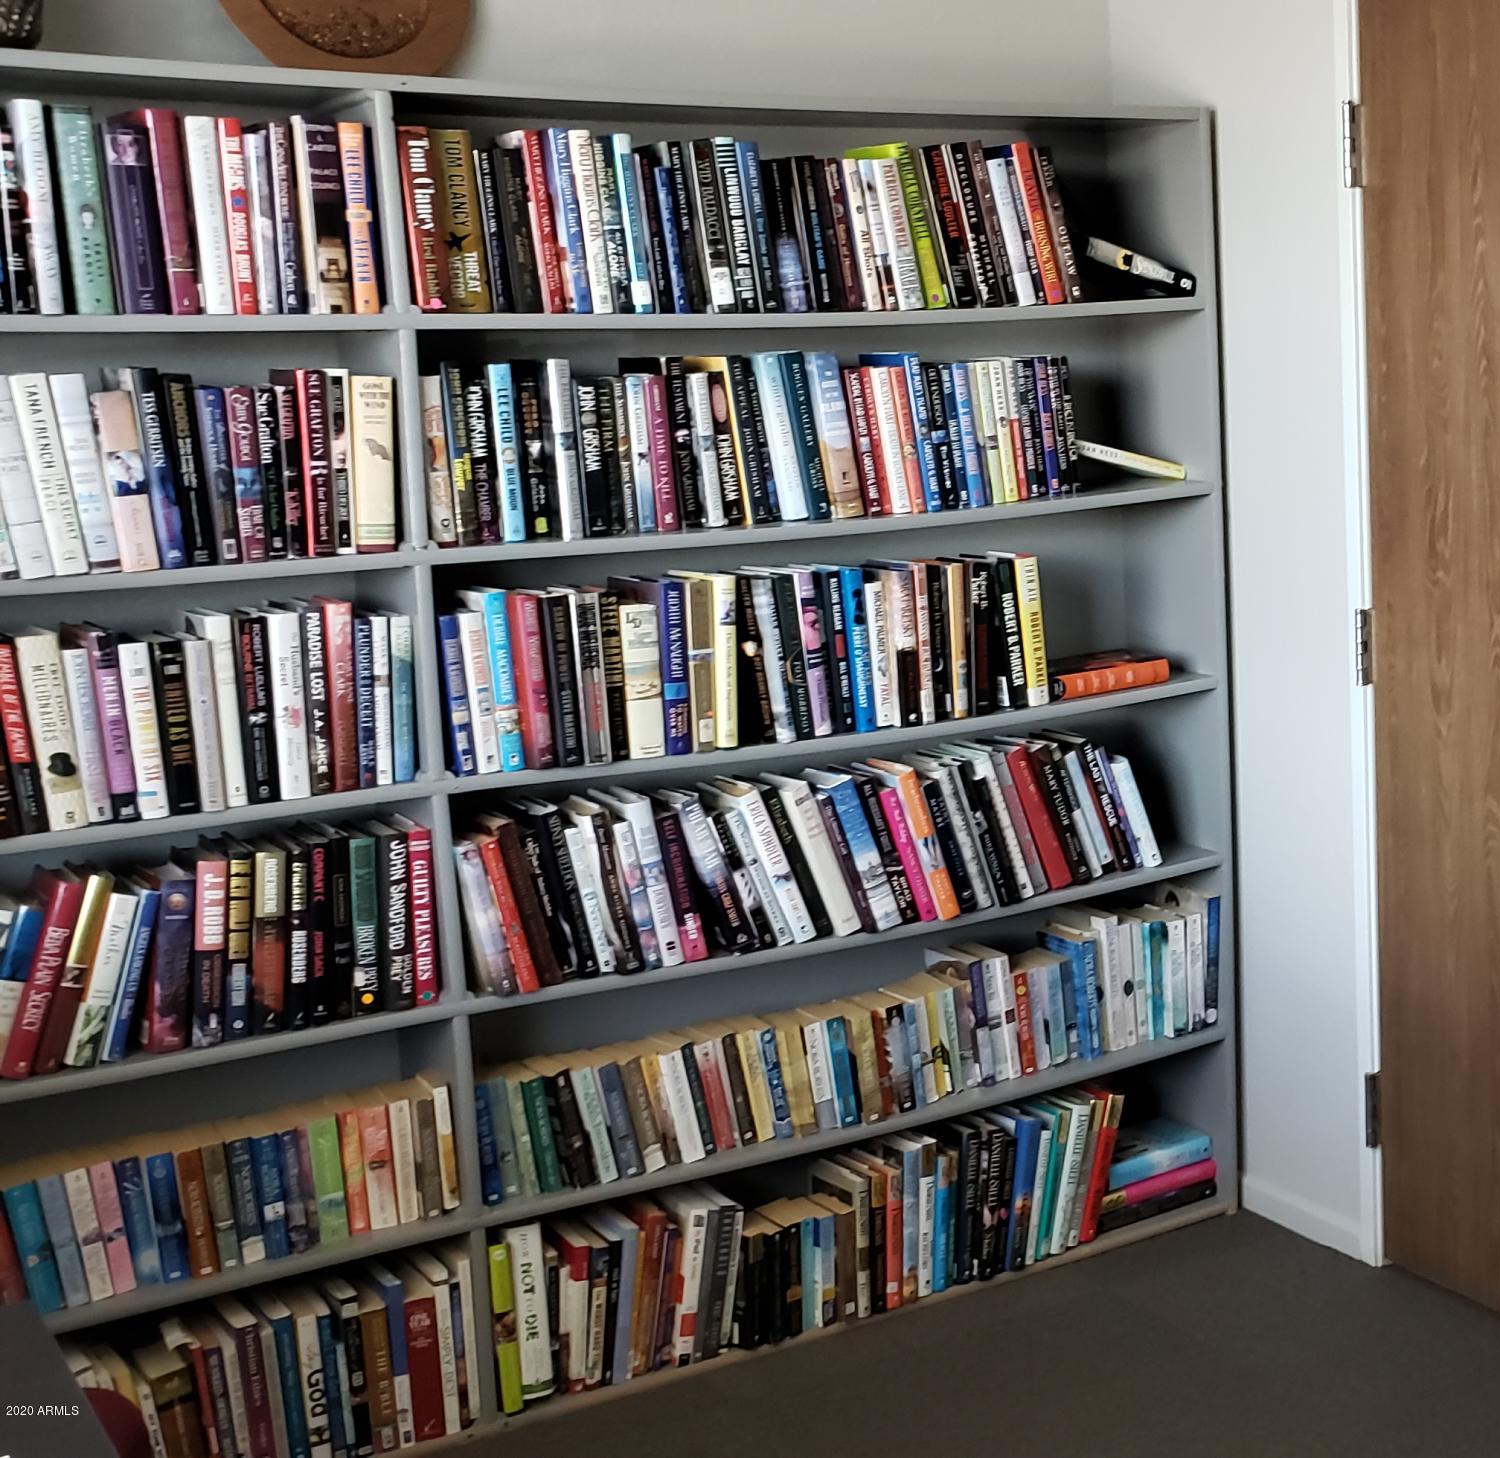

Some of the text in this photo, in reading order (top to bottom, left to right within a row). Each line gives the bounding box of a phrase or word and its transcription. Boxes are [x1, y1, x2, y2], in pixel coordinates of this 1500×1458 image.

[345, 150, 360, 167] LEE
[408, 138, 437, 231] Tom Clancy
[444, 139, 472, 228] TOM CLANCY
[955, 153, 978, 224] DISCLOSURE
[539, 203, 551, 235] CLARK
[560, 163, 580, 235] Higgins Clark
[701, 186, 721, 240] BALDACCI
[723, 168, 751, 265] LINWOOD BARCLAY
[883, 163, 909, 250] PATRICIA CORNWELL
[931, 150, 960, 239] CATHERINE COULTER
[463, 251, 482, 294] THREAT
[979, 234, 996, 285] MICHAEL
[1033, 220, 1052, 262] BURNING
[1057, 226, 1078, 276] OUTLAW
[24, 384, 57, 470] TANA FRENCH
[142, 391, 167, 468] TESS GERRITSEN
[256, 391, 277, 465] Sue Grafton
[308, 373, 325, 457] SUE GRAFTON
[577, 385, 602, 472] JOHN GRISHAM
[601, 419, 615, 453] FIRM
[732, 362, 762, 498] THE APPEAL JOHN GRISHAM
[800, 404, 815, 448] GALLERY
[467, 385, 493, 522] JOHN GRISHAM CHAMBER
[497, 387, 519, 511] LEE CHILD MOON
[655, 426, 672, 502] TIME KILL
[716, 433, 740, 502] JOHN GRISHAM
[667, 589, 681, 624] JUDITH
[829, 577, 844, 631] KILLING REAGAN
[872, 589, 887, 624] MICHAEL
[1028, 610, 1043, 646] ROBERT
[601, 595, 624, 687] STEVE MARTINI
[1000, 591, 1025, 687] ROBERT PARKER
[30, 664, 59, 743] MILLIONAIRES
[305, 612, 329, 775] PARADISE LOST JANCE
[358, 624, 374, 729] PLUNDER DECEIT
[495, 649, 513, 702] MACOMBER
[11, 726, 29, 760] FAMILY
[102, 676, 127, 756] MEN IN BLACK
[163, 681, 193, 767] UNITED AS ONE
[795, 687, 810, 734] MORRISON
[1042, 765, 1070, 828] MARY TUDOR
[1083, 743, 1119, 828] THE LAST RESCUE
[745, 799, 784, 868] ERICA SPINDLER
[768, 796, 793, 846] Elizabeth
[263, 858, 279, 914] ROSENBERG
[312, 847, 325, 894] COMPANY
[388, 839, 408, 951] JOHN SANDFORD
[889, 873, 907, 910] TAYLOR
[899, 875, 913, 903] BRAD
[203, 906, 226, 945] ROBB
[355, 924, 378, 965] BROKEN
[412, 859, 434, 982] GUILTY PLEASURES
[201, 971, 211, 1004] DEATH
[290, 929, 308, 984] ROSENBERG
[390, 954, 403, 982] PREY
[21, 955, 63, 1033] PLAIN SECRECY
[987, 1132, 1005, 1207] DANIELLE STEEL
[1066, 1113, 1090, 1186] DANIELLE STEEL
[519, 1261, 537, 1296] NOT
[374, 1350, 388, 1371] THE
[439, 1325, 452, 1366] SIMPLY
[523, 1312, 540, 1343] DIE
[244, 1327, 263, 1408] Christian Ethics
[307, 1368, 328, 1418] God
